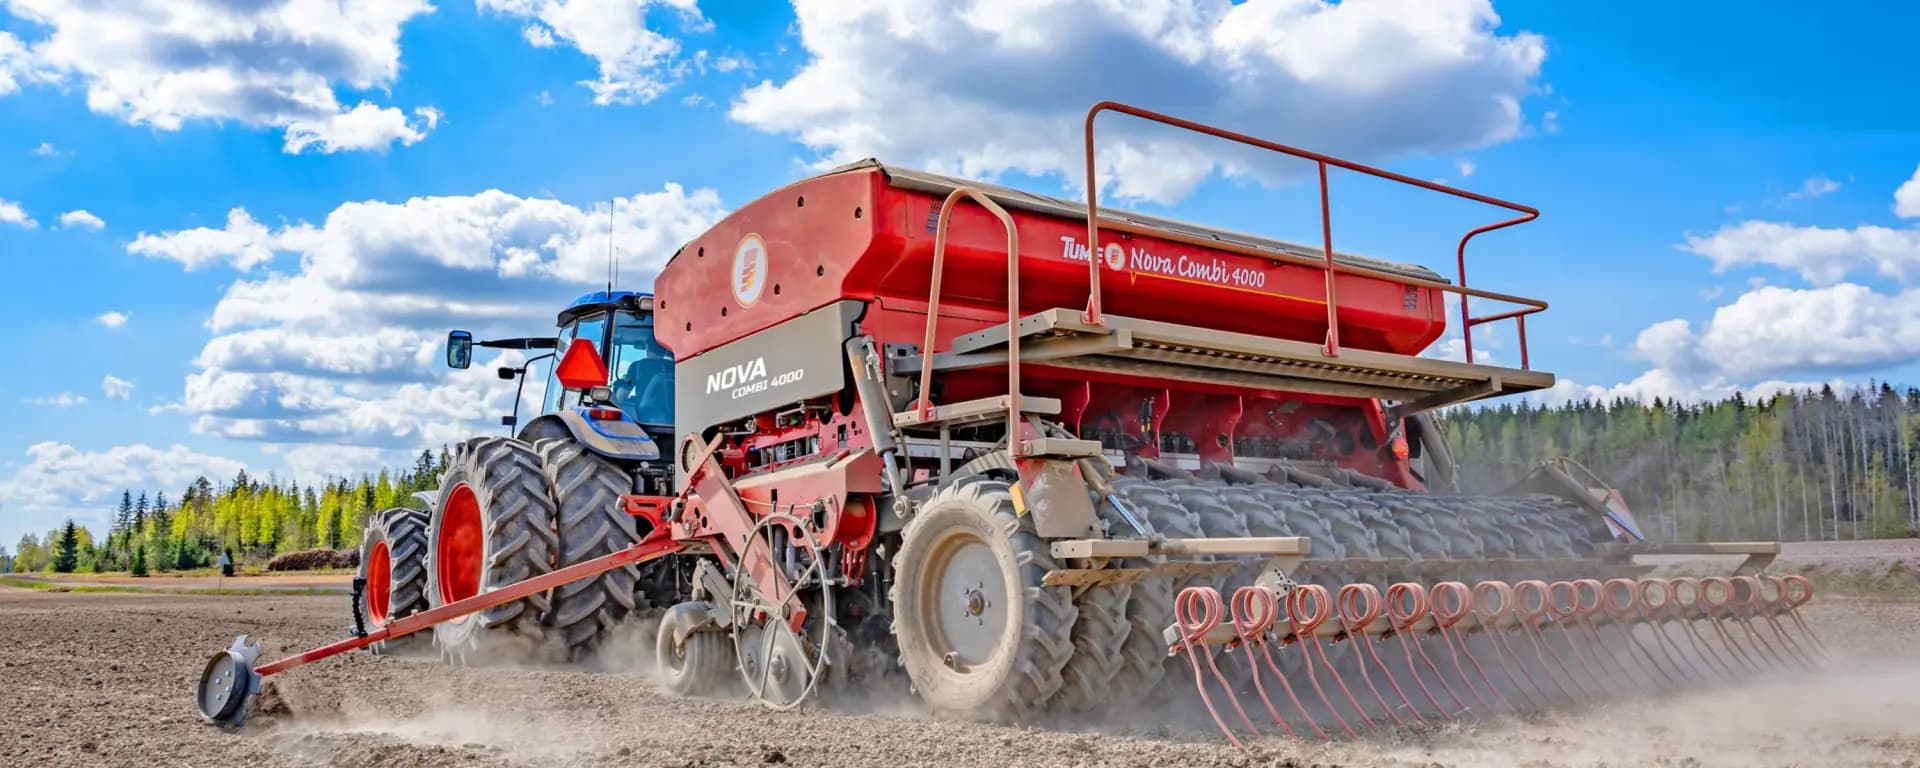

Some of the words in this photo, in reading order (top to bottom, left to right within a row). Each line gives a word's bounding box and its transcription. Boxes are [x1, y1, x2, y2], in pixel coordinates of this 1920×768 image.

[1130, 248, 1175, 275] Nova
[1178, 256, 1229, 283] Combi
[1232, 269, 1265, 288] 4000
[706, 357, 767, 394] NOVA
[732, 380, 768, 399] COMBI
[770, 368, 804, 387] 4000
